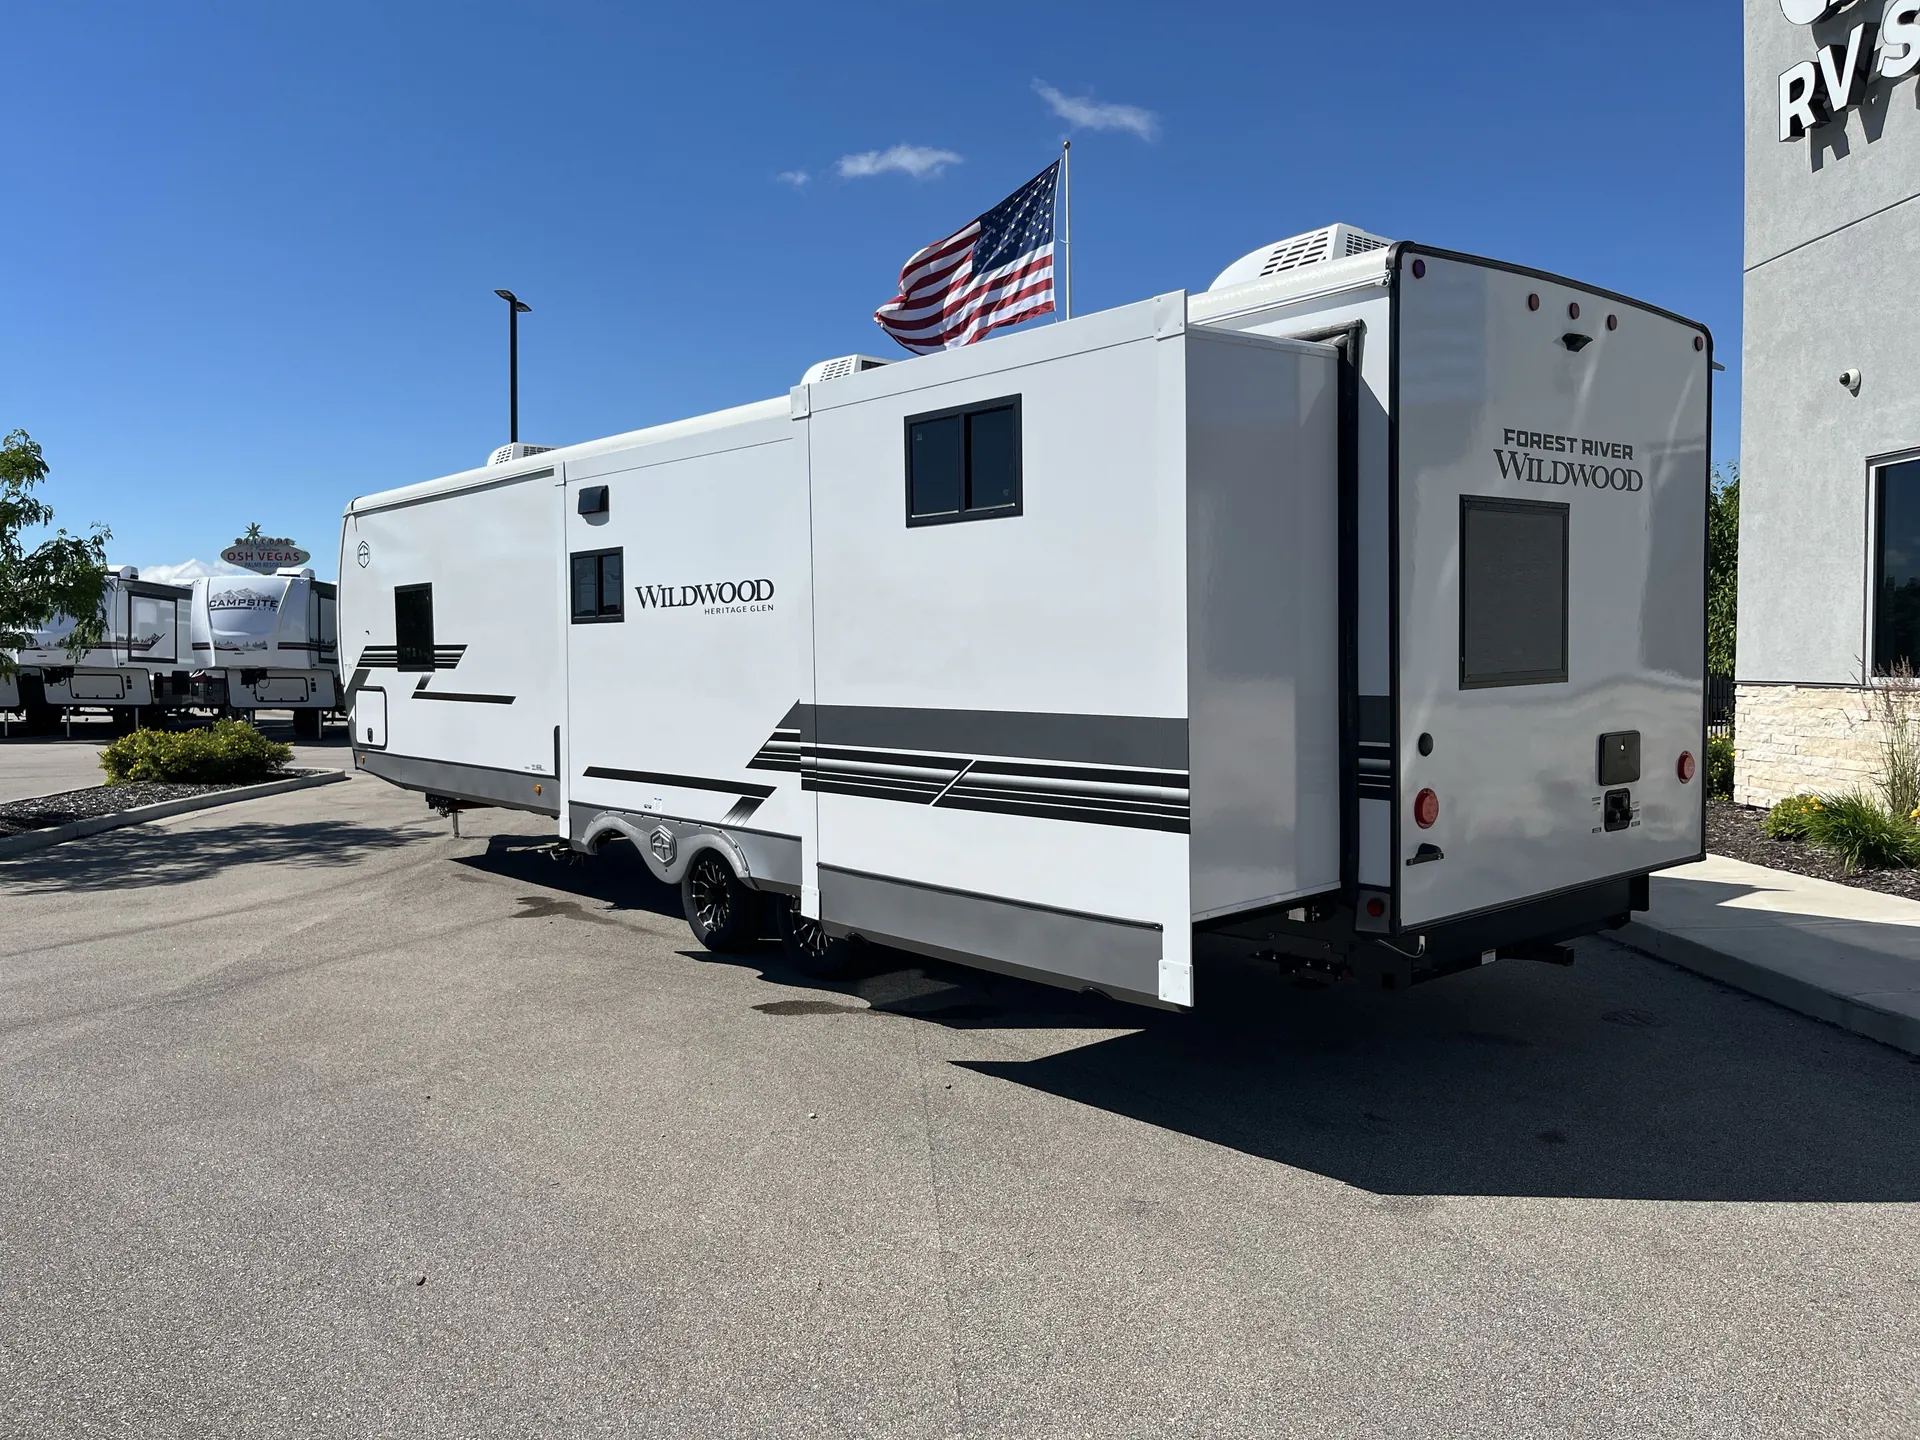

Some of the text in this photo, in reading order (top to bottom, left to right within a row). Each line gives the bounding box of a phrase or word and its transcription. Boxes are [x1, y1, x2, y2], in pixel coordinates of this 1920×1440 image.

[1778, 22, 1865, 142] RV
[1503, 428, 1633, 460] FOREST RIVER
[1493, 448, 1643, 492] WILDWOOD
[227, 551, 300, 562] OSH VEGAS
[209, 599, 279, 608] CAMPSITE
[635, 578, 775, 609] WILDWOOD
[704, 604, 774, 615] HERITAGE GLEN
